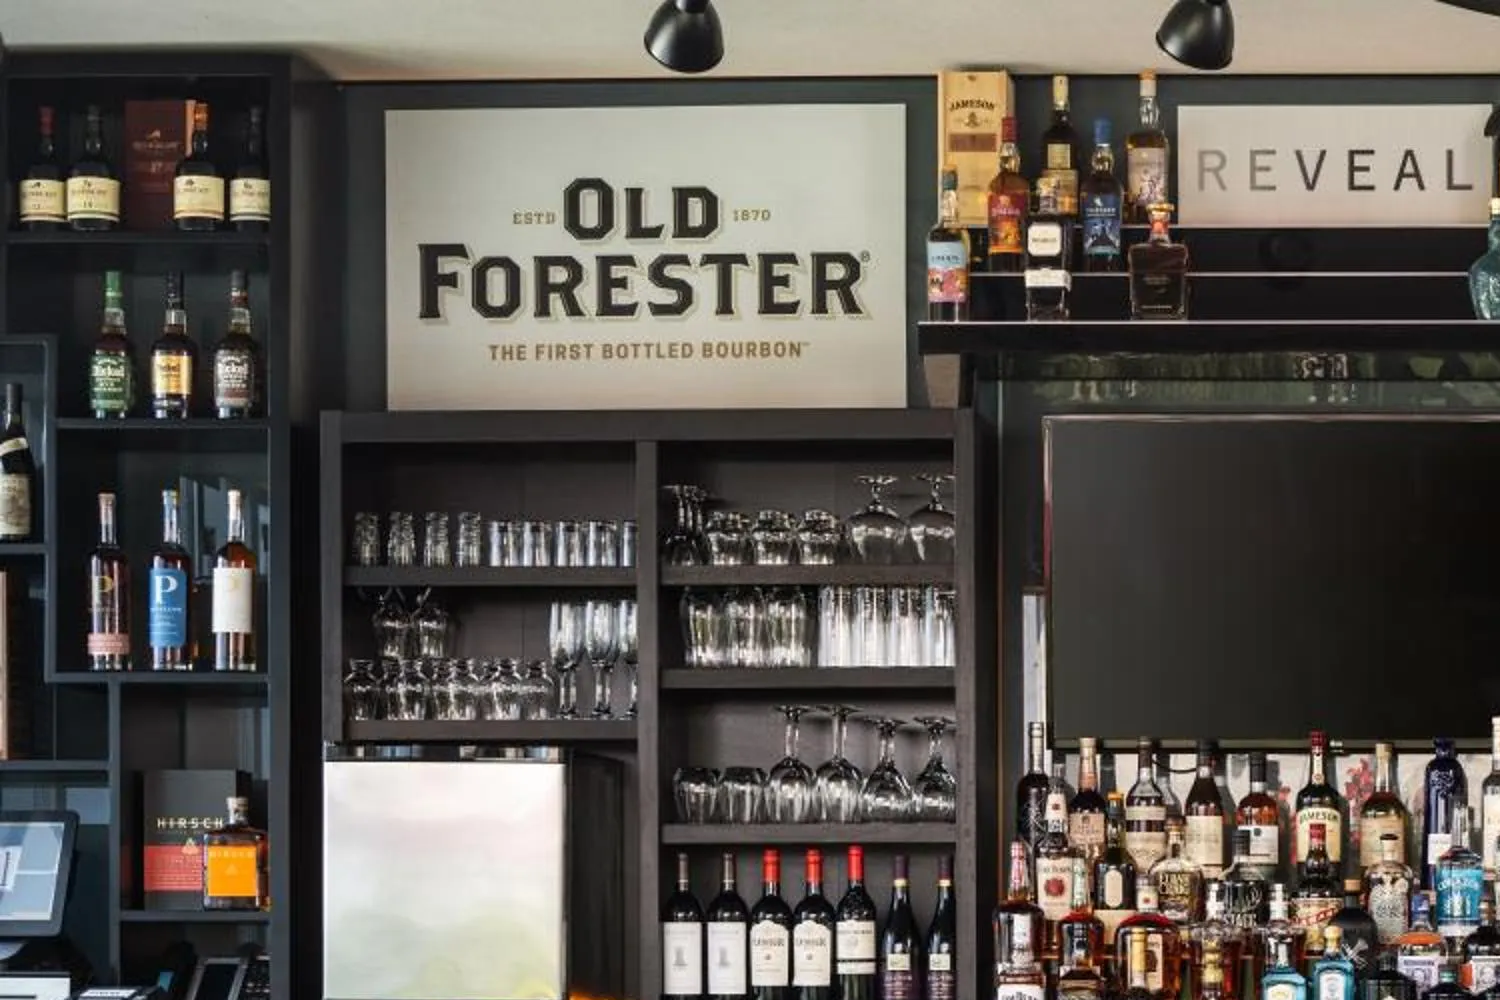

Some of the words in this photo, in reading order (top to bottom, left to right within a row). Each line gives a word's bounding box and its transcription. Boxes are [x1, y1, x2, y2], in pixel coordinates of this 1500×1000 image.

[949, 99, 996, 111] JAMESON
[1197, 148, 1474, 192] REVEAL
[512, 211, 556, 225] ESTD
[563, 177, 720, 241] OLD
[733, 208, 772, 222] 1870
[417, 243, 864, 320] FORESTER
[489, 344, 527, 361] THE
[535, 343, 593, 361] FIRST
[602, 343, 694, 360] BOTTLED
[702, 341, 803, 359] BOURBON
[154, 575, 179, 604] P
[156, 816, 225, 830] HIRSCH
